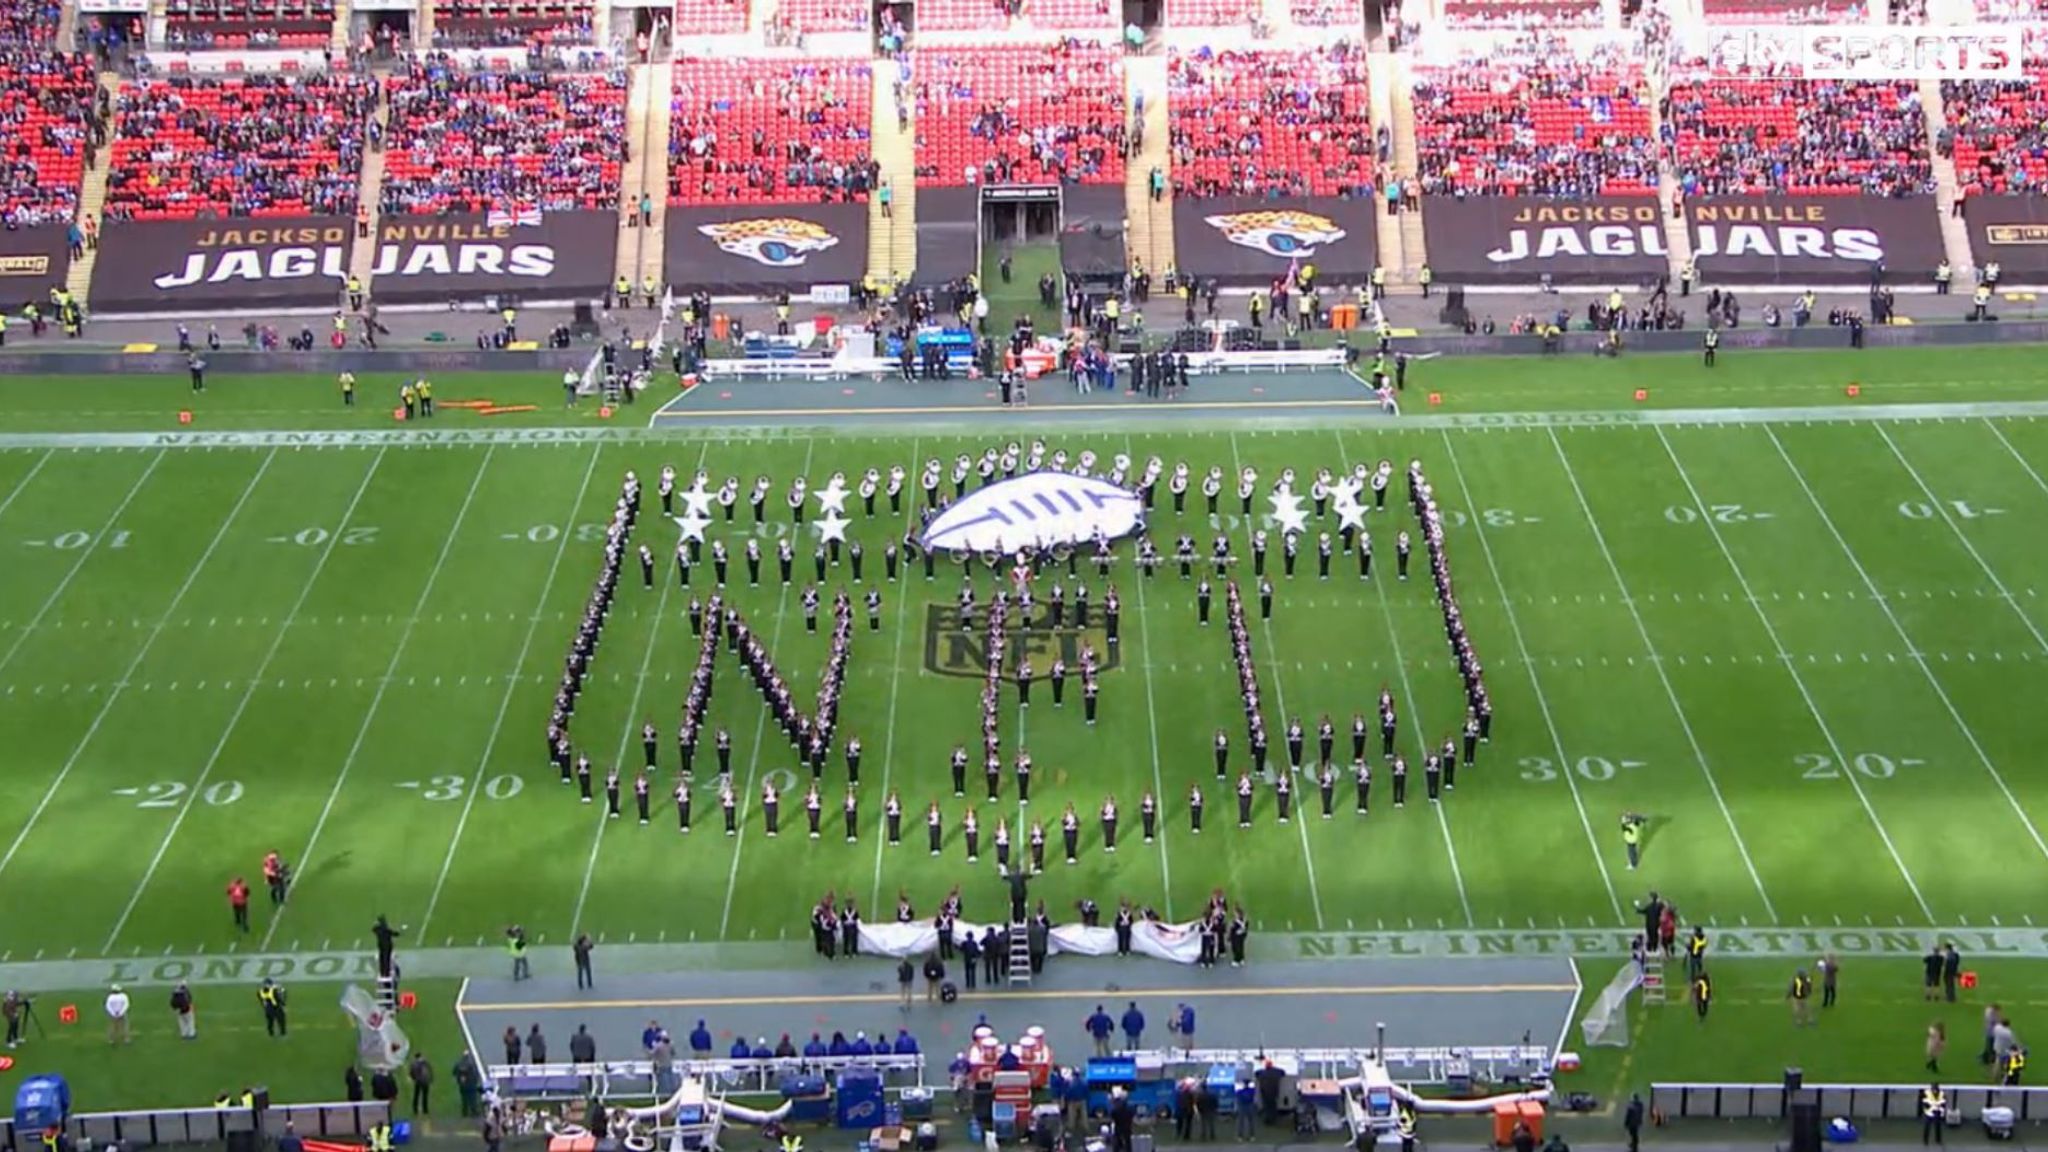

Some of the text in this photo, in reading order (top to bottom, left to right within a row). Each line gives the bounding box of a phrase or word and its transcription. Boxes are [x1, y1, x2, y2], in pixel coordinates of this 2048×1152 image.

[1450, 412, 1640, 426] LONDON
[154, 434, 242, 445] NFL
[263, 429, 648, 444] INTERNATIONAL
[1517, 755, 1616, 782] 30
[1794, 752, 1897, 779] 20
[136, 780, 245, 808] 20
[424, 774, 525, 801] 30
[1299, 935, 1424, 957] NFL
